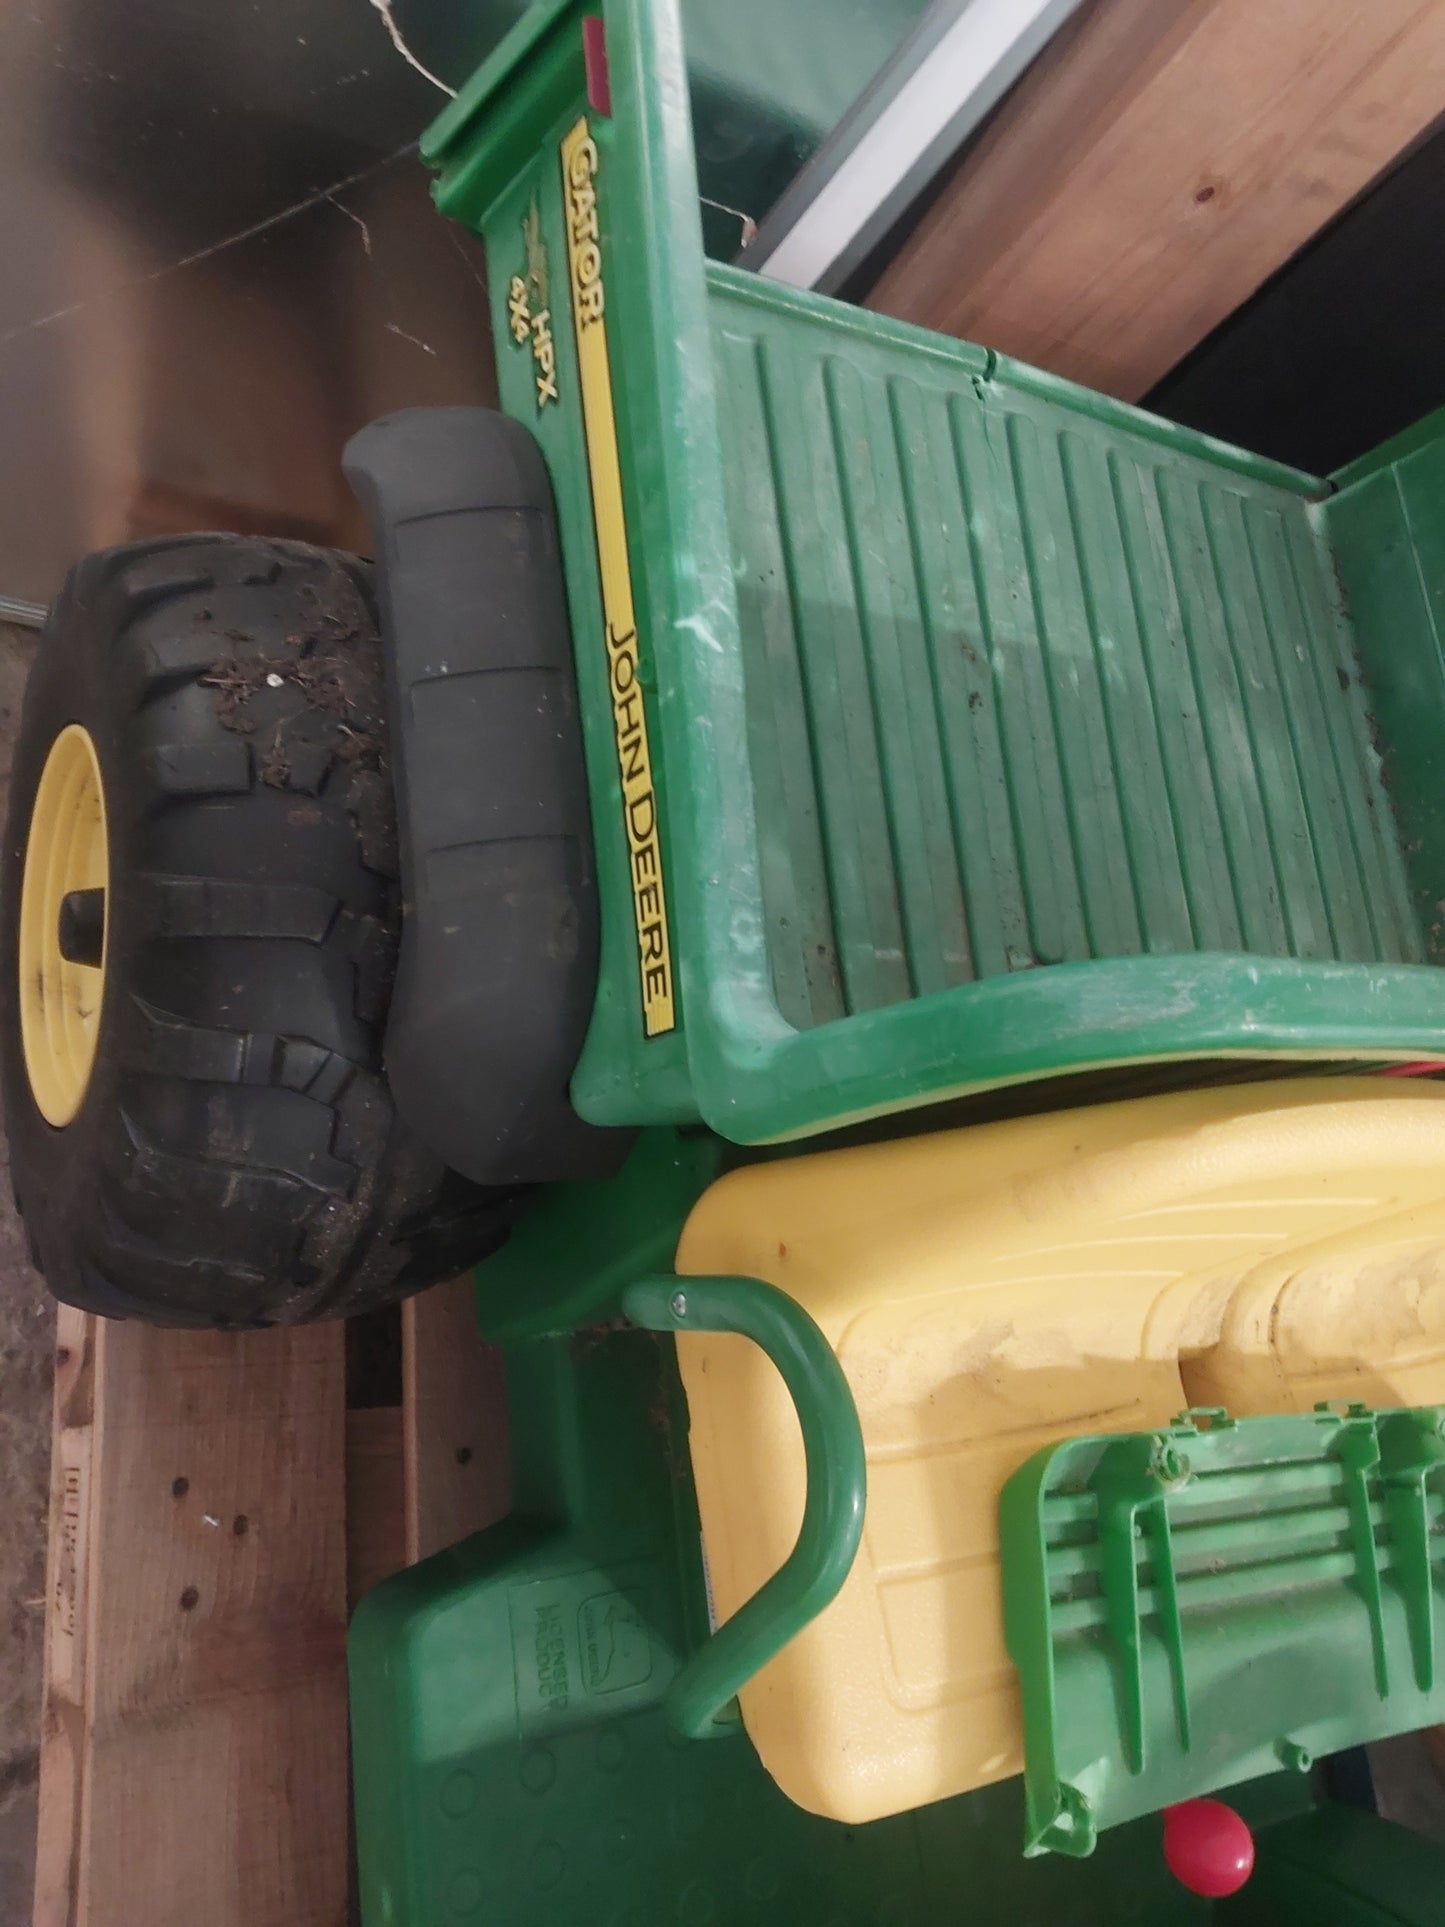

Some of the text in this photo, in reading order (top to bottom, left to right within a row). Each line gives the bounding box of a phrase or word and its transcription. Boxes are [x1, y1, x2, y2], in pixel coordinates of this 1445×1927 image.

[570, 137, 604, 332] GATOR
[531, 308, 558, 408] HPX
[608, 622, 668, 1003] JOHN DEERE
